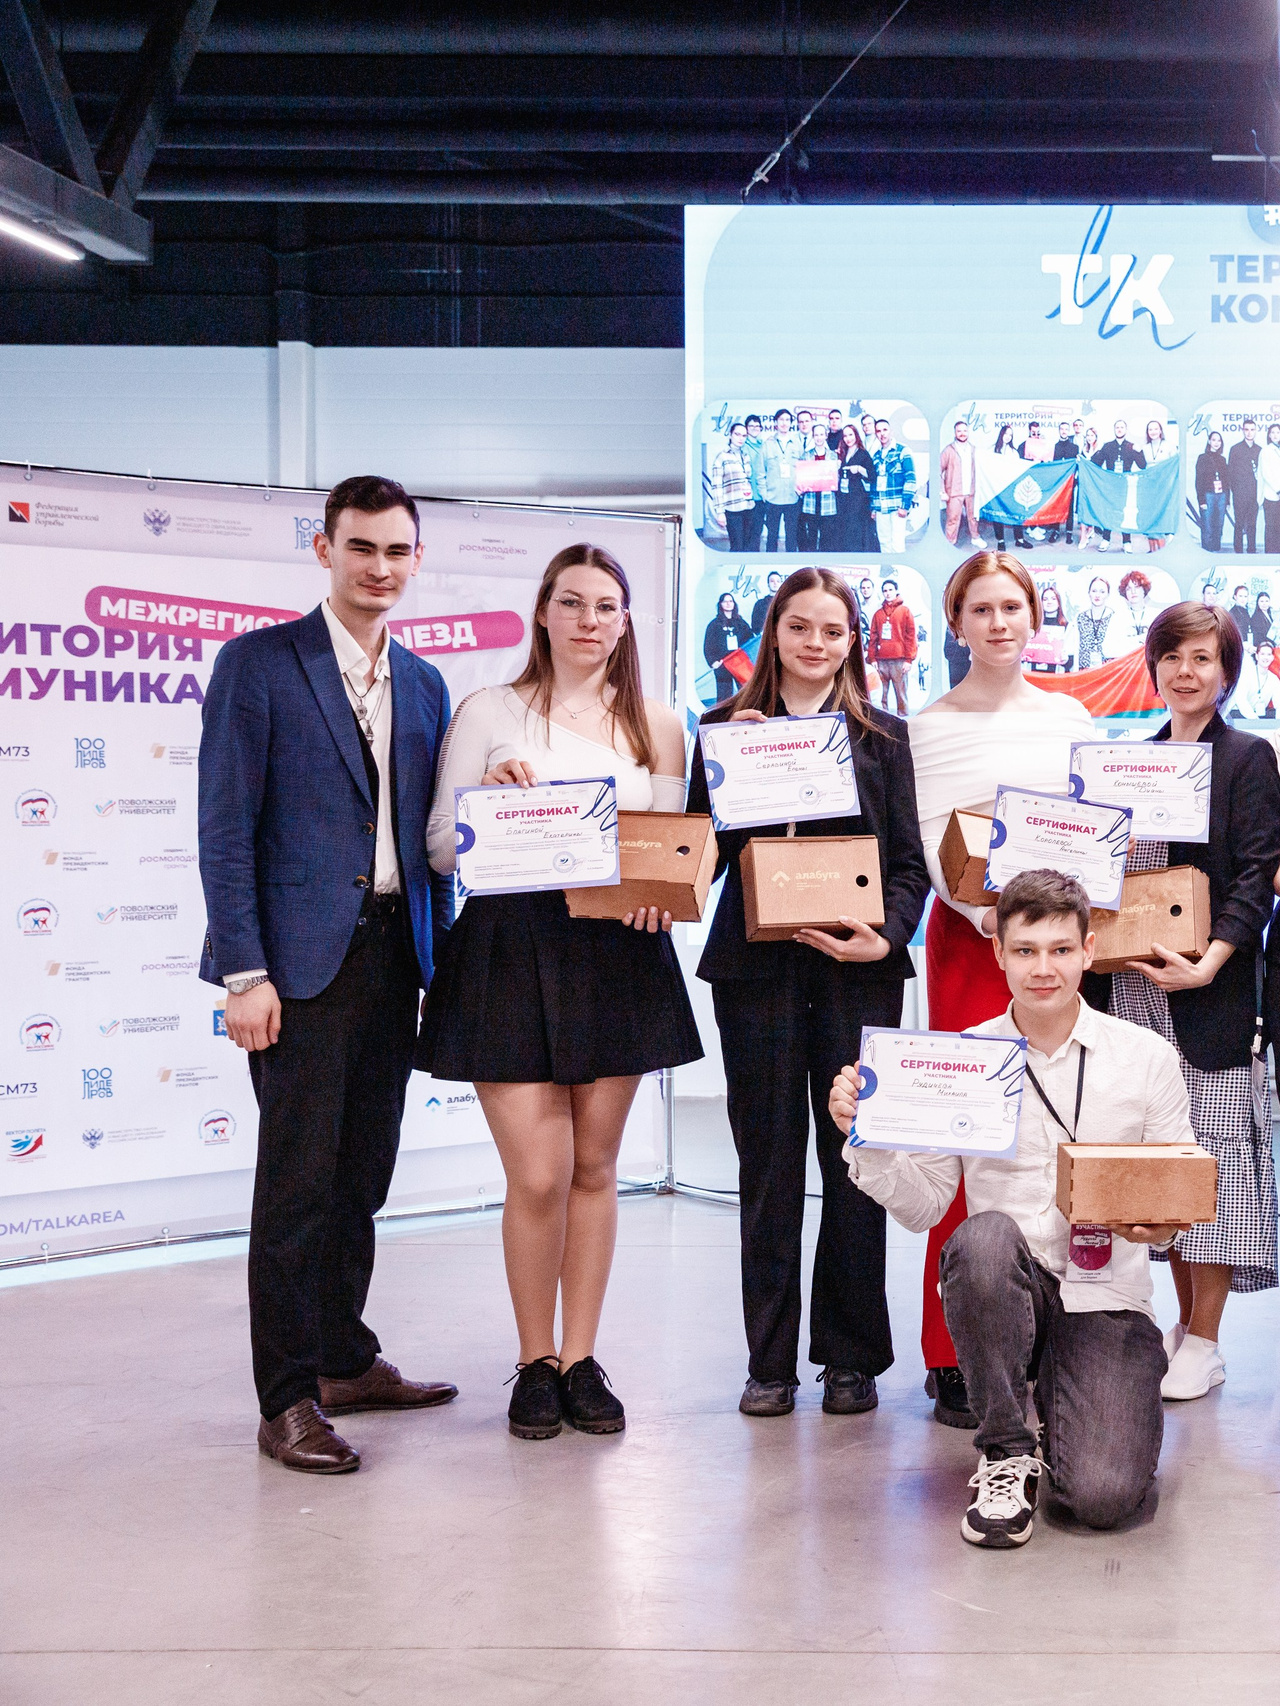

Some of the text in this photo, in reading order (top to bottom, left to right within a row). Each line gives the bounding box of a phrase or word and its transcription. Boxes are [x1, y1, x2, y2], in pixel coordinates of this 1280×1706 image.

[294, 517, 325, 531] 100
[460, 544, 528, 556] росмолодёжь
[100, 596, 288, 634] МЕЖРЕГИО
[391, 621, 477, 649] ЫЕЗД
[0, 622, 203, 662] ИТОРИЯ
[74, 738, 105, 750] 100
[740, 740, 816, 755] СЕРТИФИКАТ
[1103, 765, 1178, 773] СЕРТИФИКАТ
[118, 798, 176, 806] ПОВОЛЖСКИЙ
[496, 806, 580, 820] СЕРТИФИКАТ
[1026, 816, 1098, 835] СЕРТИФИКАТ
[1044, 830, 1072, 838] УЧАСТНИКА
[796, 870, 841, 882] алабуга
[120, 903, 178, 912] ПОВОЛЖСКИЙ
[120, 914, 178, 922] УНИВЕРСИТЕТ
[122, 1014, 180, 1024] ПОВОЛЖСКИЙ
[123, 1024, 180, 1034] УНИВЕРСИТЕТ
[901, 1059, 986, 1074] СЕРТИФИКАТ
[82, 1068, 112, 1080] 100
[924, 1072, 957, 1080] УЧАСТНИКА
[0, 1210, 126, 1236] OM/TALKAREA
